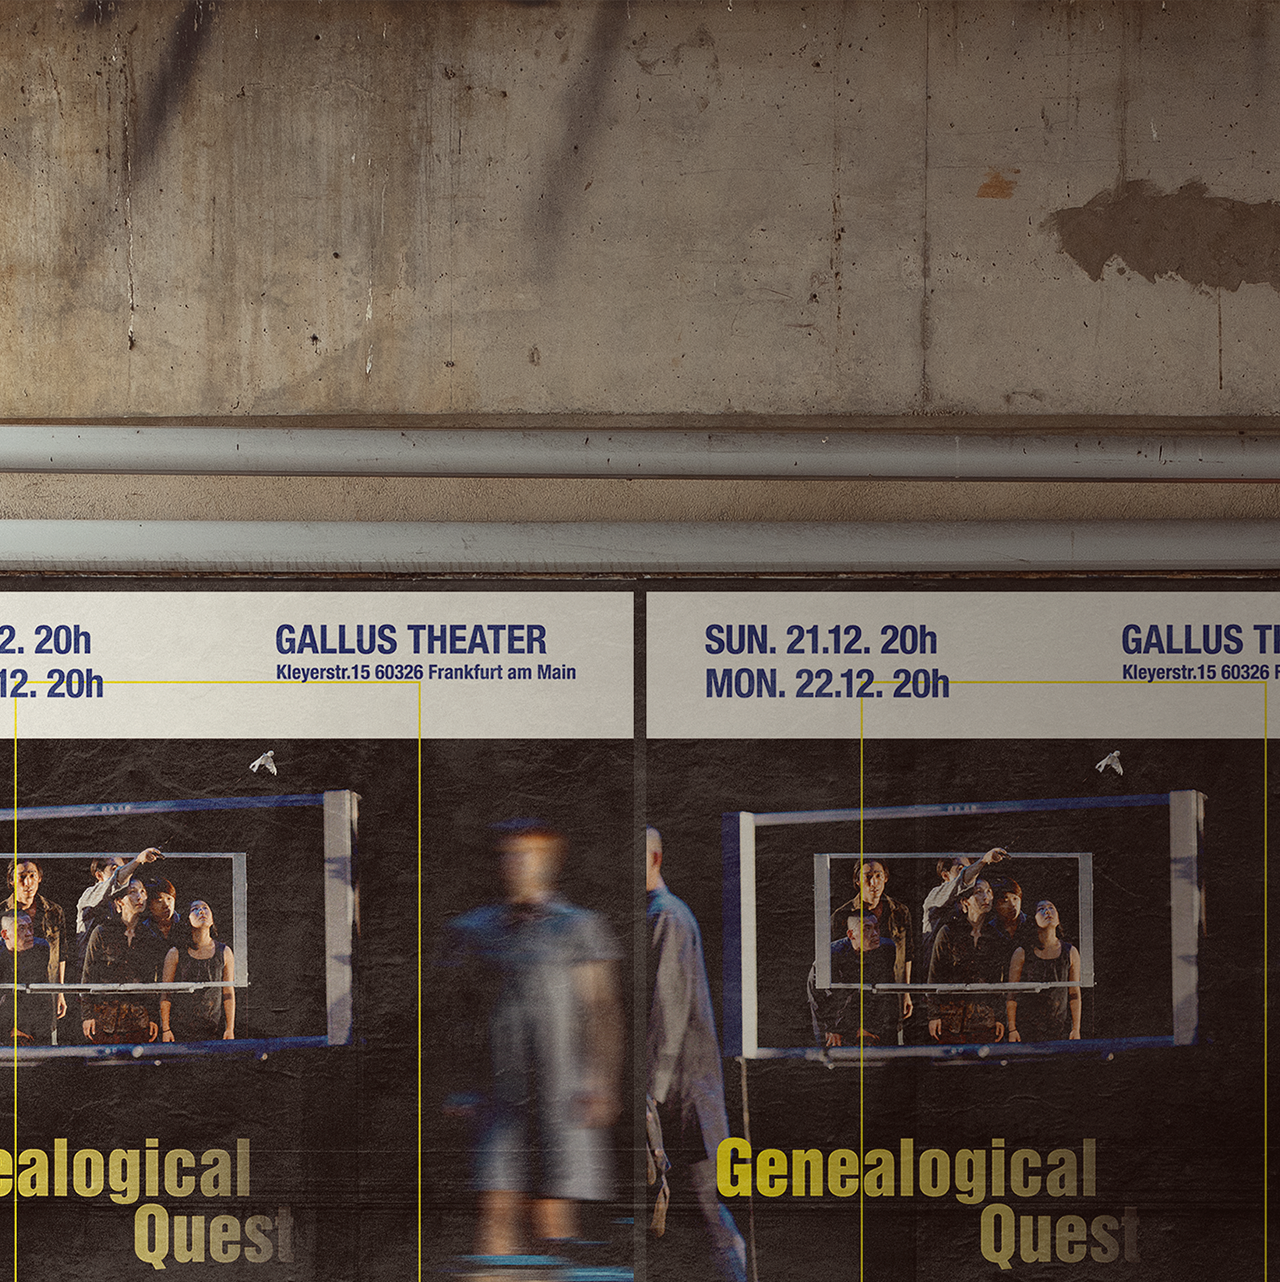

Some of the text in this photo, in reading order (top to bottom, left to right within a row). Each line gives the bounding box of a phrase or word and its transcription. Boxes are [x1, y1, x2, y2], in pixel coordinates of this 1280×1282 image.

[35, 625, 90, 654] 20h
[276, 624, 547, 654] GALLUS THEATER
[705, 624, 936, 654] SUN. 21.12. 20h
[1122, 624, 1243, 654] GALLUS
[47, 669, 103, 698] 20h
[277, 664, 576, 683] Kleyerstr.15 60326 Frankfurt am Main
[707, 668, 949, 698] MON. 22.12. 20h
[1123, 664, 1216, 683] Kleyerstr.15
[1221, 664, 1269, 680] 60326
[716, 1137, 1097, 1204] Genealogical
[134, 1203, 294, 1270] Quest
[980, 1203, 1140, 1270] Quest
